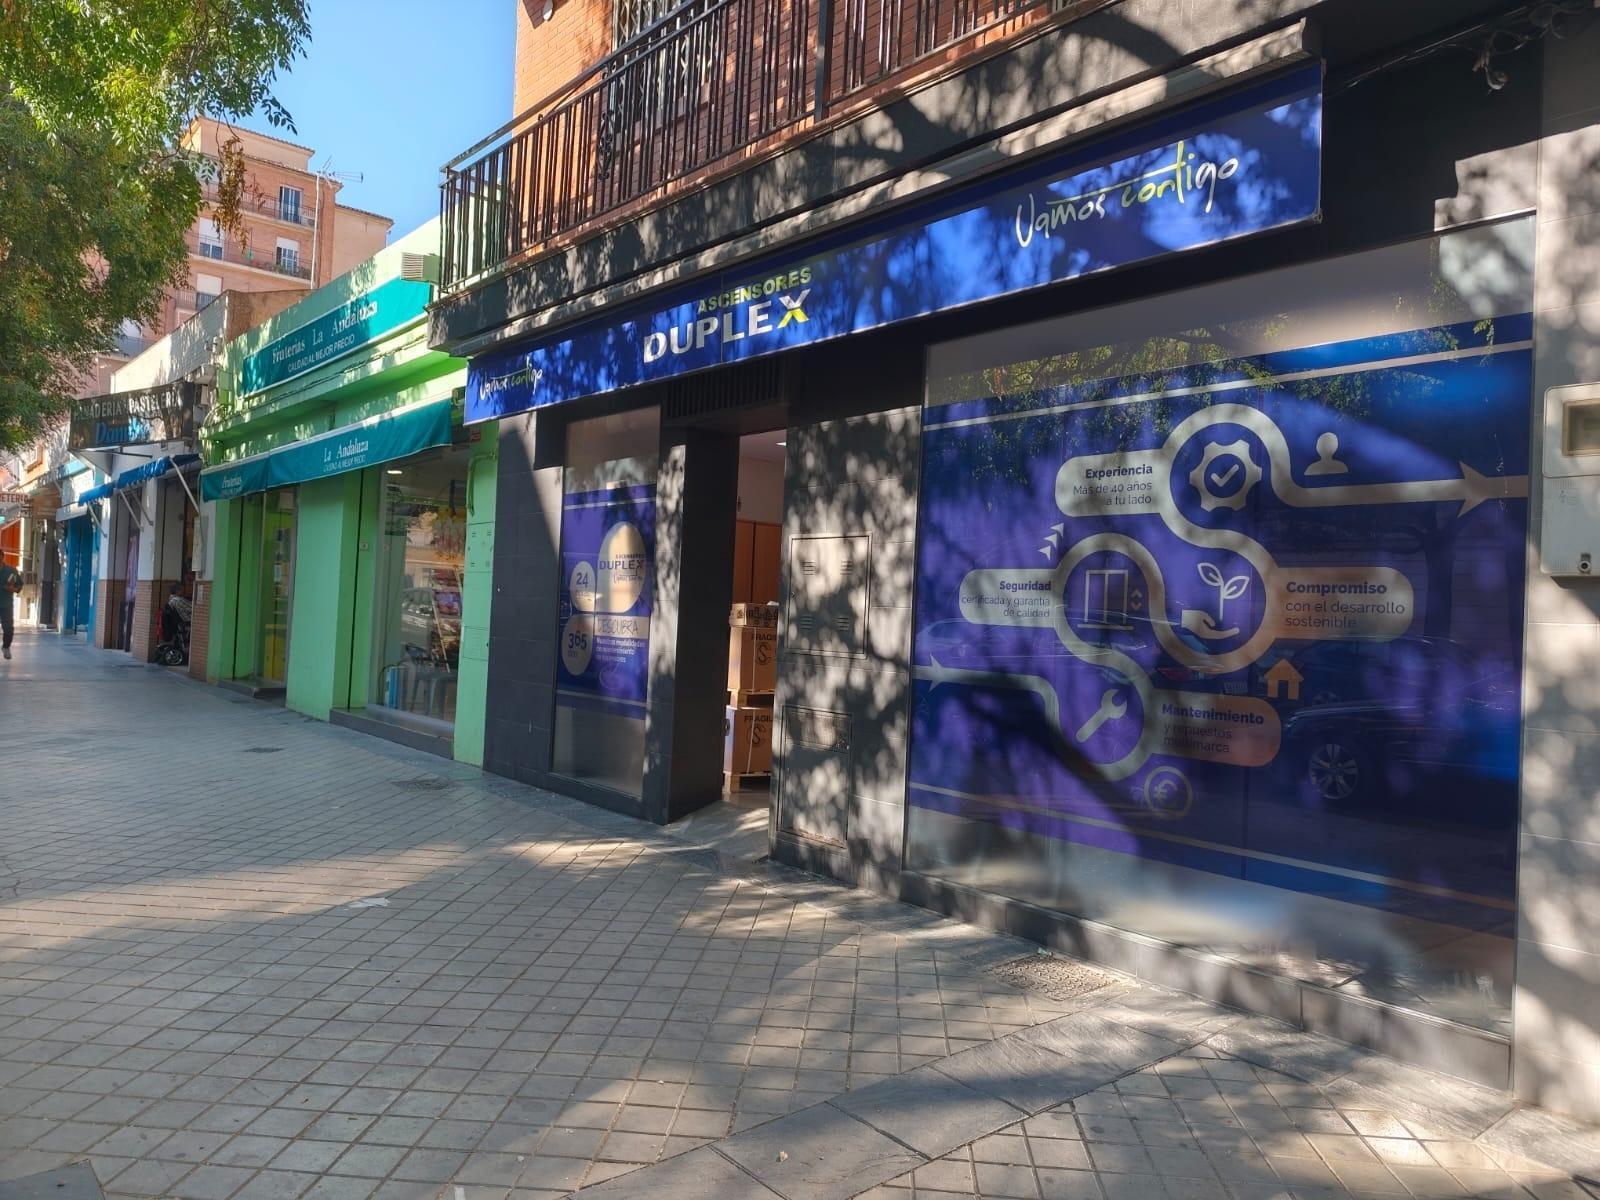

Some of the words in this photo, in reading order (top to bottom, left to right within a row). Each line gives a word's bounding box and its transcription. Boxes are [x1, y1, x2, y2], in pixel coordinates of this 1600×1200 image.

[1015, 193, 1106, 248] Vamos
[1120, 140, 1239, 214] contigo
[697, 267, 813, 314] ASCENSORES
[312, 327, 323, 346] La
[331, 300, 378, 336] Andaluza
[643, 289, 810, 363] DUPLEX
[1085, 464, 1153, 480] Experiencia
[1095, 483, 1109, 493] de
[1111, 483, 1124, 493] 40
[1126, 481, 1153, 492] años
[1106, 497, 1113, 506] a
[1127, 494, 1152, 505] lado
[600, 560, 644, 570] DUPLEX
[576, 572, 589, 589] 24
[999, 580, 1052, 593] Seguridad
[1286, 581, 1388, 596] Compromiso
[1003, 608, 1014, 617] de
[1015, 607, 1050, 618] calidad
[1285, 603, 1310, 613] con
[1313, 602, 1328, 612] el
[1331, 602, 1406, 615] desarrollo
[1285, 615, 1357, 629] sostenible
[568, 630, 588, 650] 365
[1162, 703, 1265, 726] Mantenimiento
